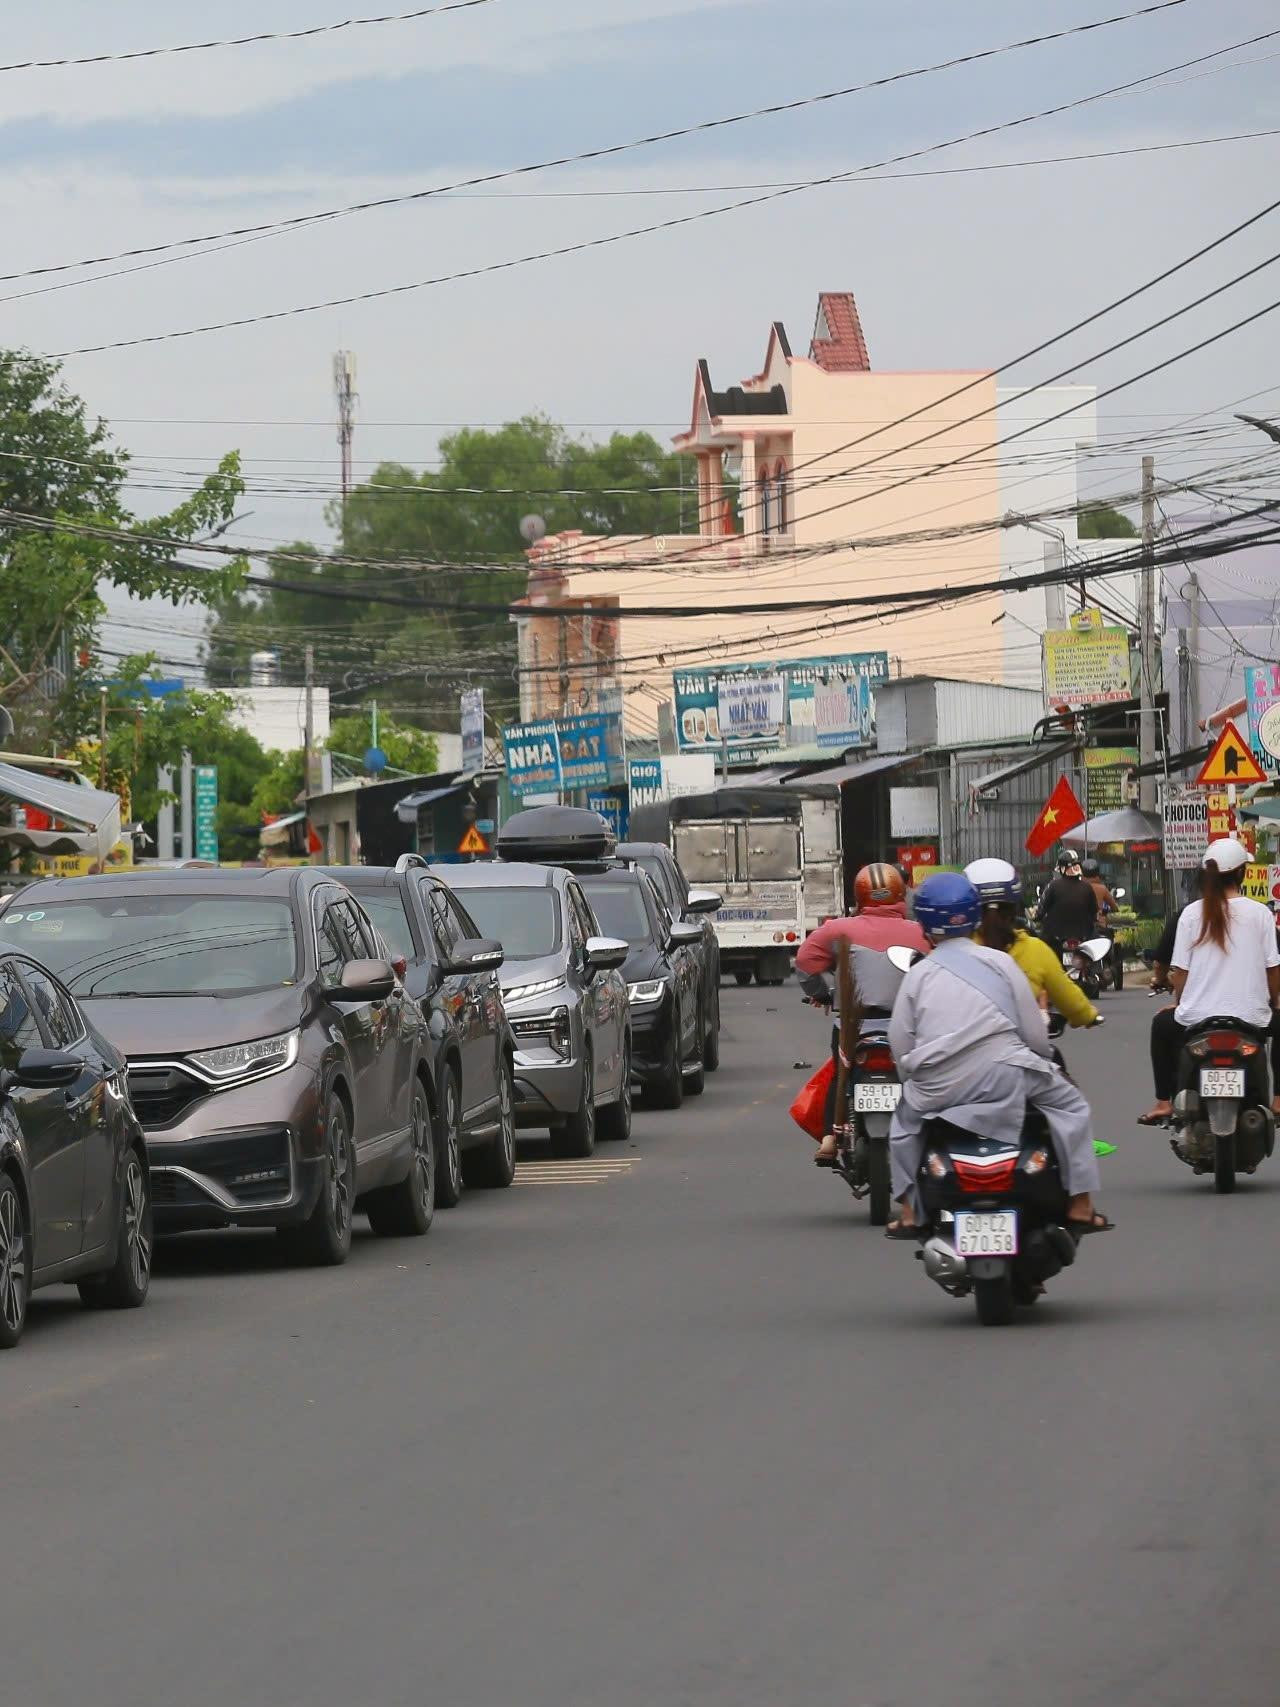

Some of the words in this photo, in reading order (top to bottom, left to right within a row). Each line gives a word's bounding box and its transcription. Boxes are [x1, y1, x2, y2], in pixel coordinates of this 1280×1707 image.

[1208, 1071, 1237, 1083] 60-C2
[862, 1086, 893, 1096] 59-C1
[966, 1215, 1006, 1232] 60-C2
[960, 1235, 1012, 1252] 670.58
